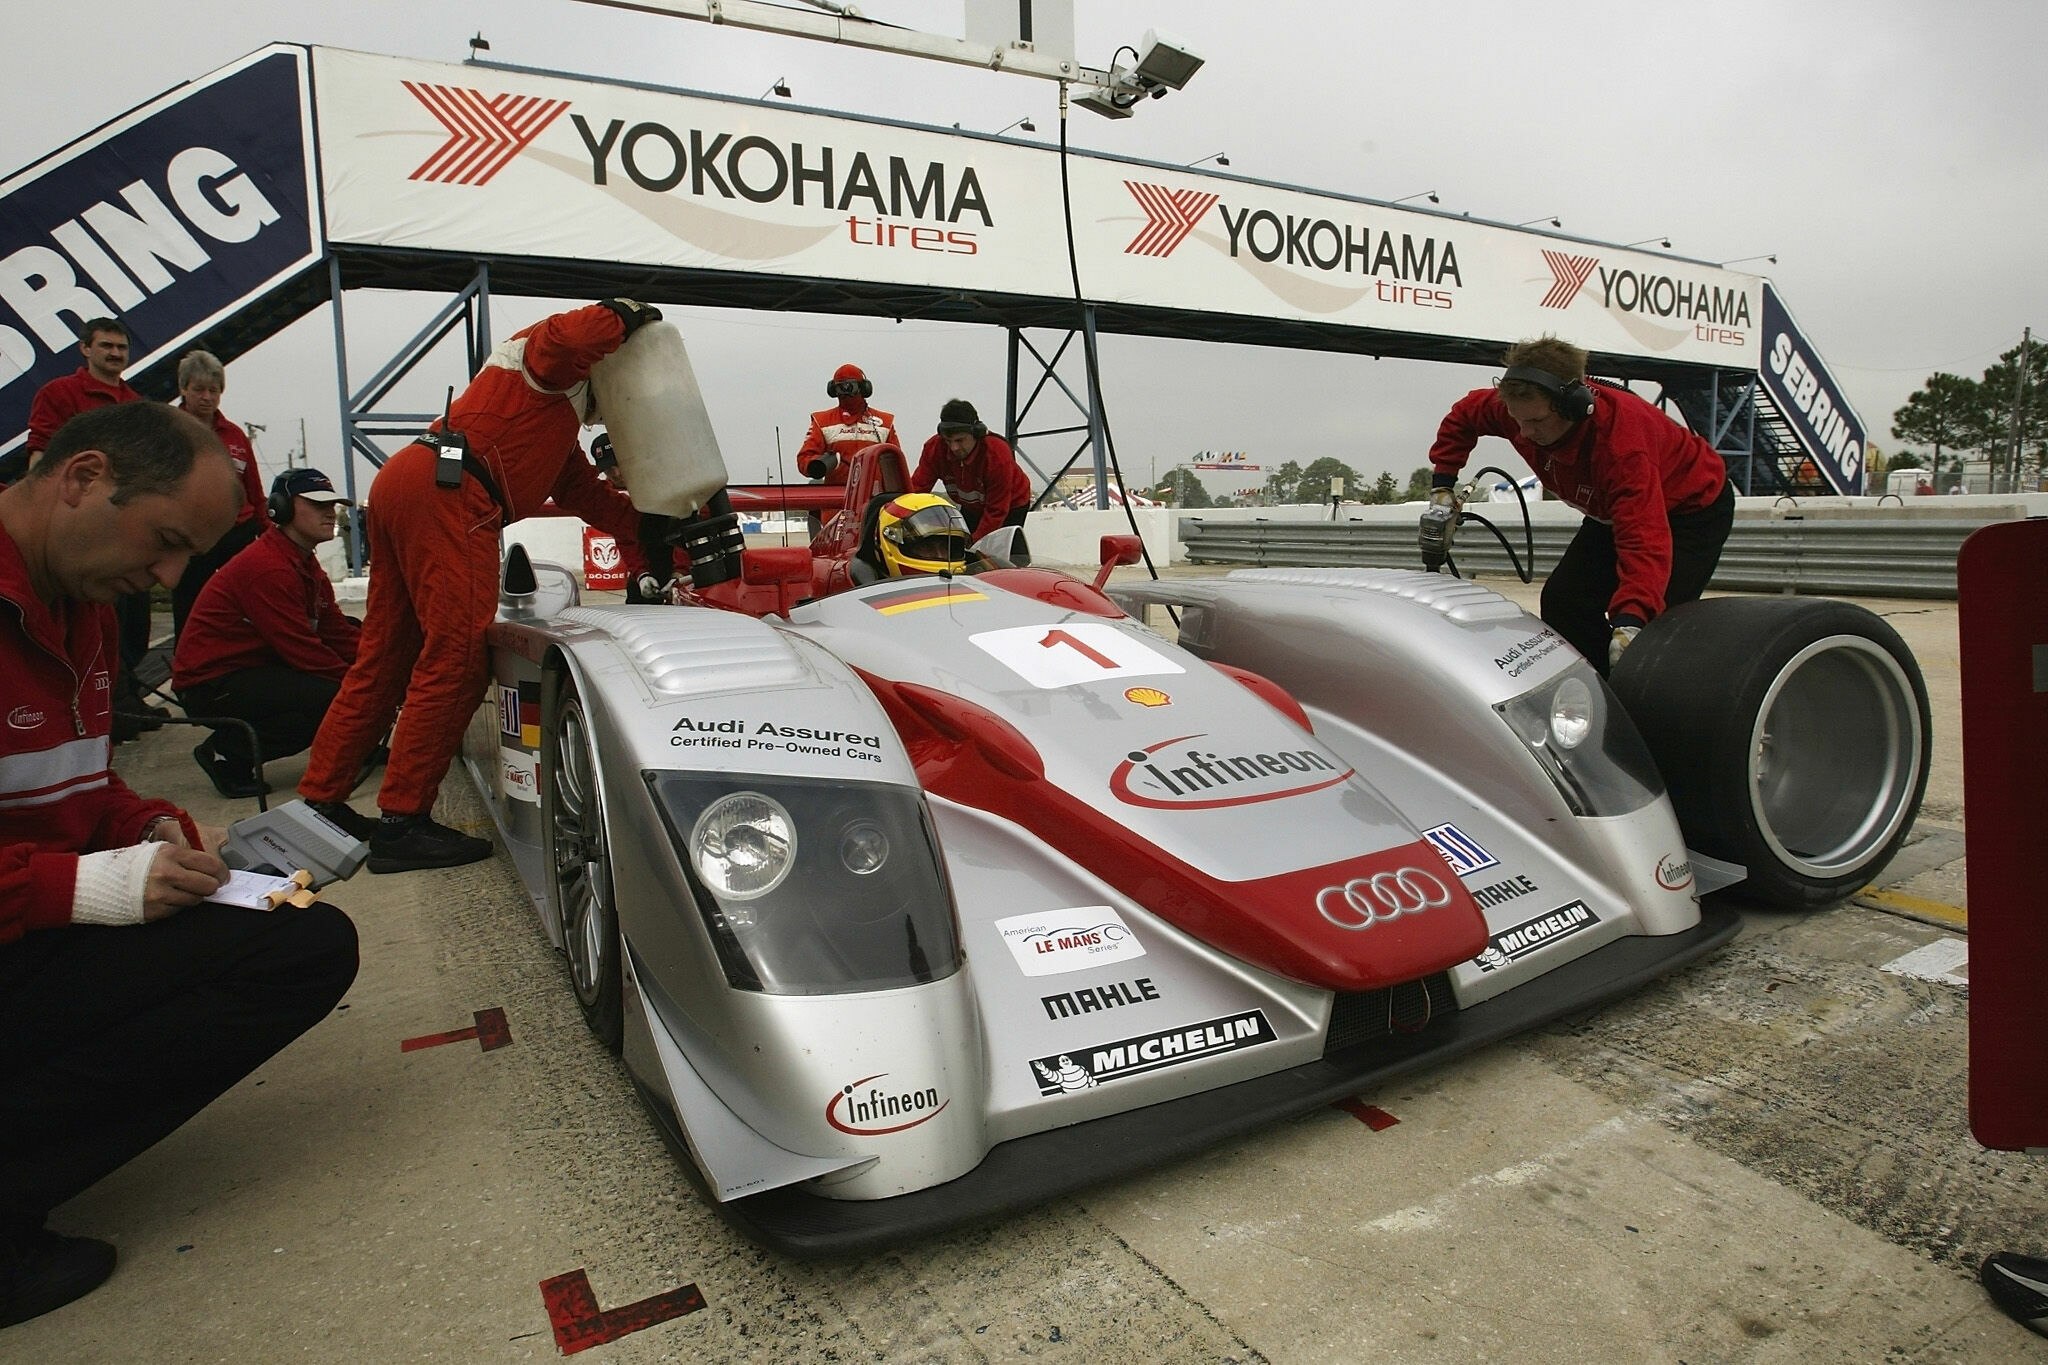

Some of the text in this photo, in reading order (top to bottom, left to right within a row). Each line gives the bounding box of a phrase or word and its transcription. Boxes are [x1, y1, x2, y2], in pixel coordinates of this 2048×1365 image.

[570, 113, 994, 228] YOKOHAMA
[845, 215, 978, 256] tires
[1218, 204, 1463, 288] YOKOHAMA
[1375, 279, 1453, 310] tires
[1599, 266, 1751, 328] YOKOHAMA
[1695, 323, 1745, 347] tires
[1769, 332, 1860, 482] SEBRING
[1037, 629, 1122, 669] 1
[1494, 647, 1522, 669] Audi
[670, 736, 882, 763] Certified Pre-Owned Cars
[672, 717, 881, 749] Audi Assured
[1472, 874, 1539, 911] MAHLE
[1003, 924, 1047, 937] American
[1035, 932, 1101, 954] LE MANS
[1087, 942, 1119, 954] Series
[1498, 904, 1589, 954] MICHELIN
[1040, 977, 1160, 1020] MAHLE
[1092, 1016, 1260, 1073] MICHELIN
